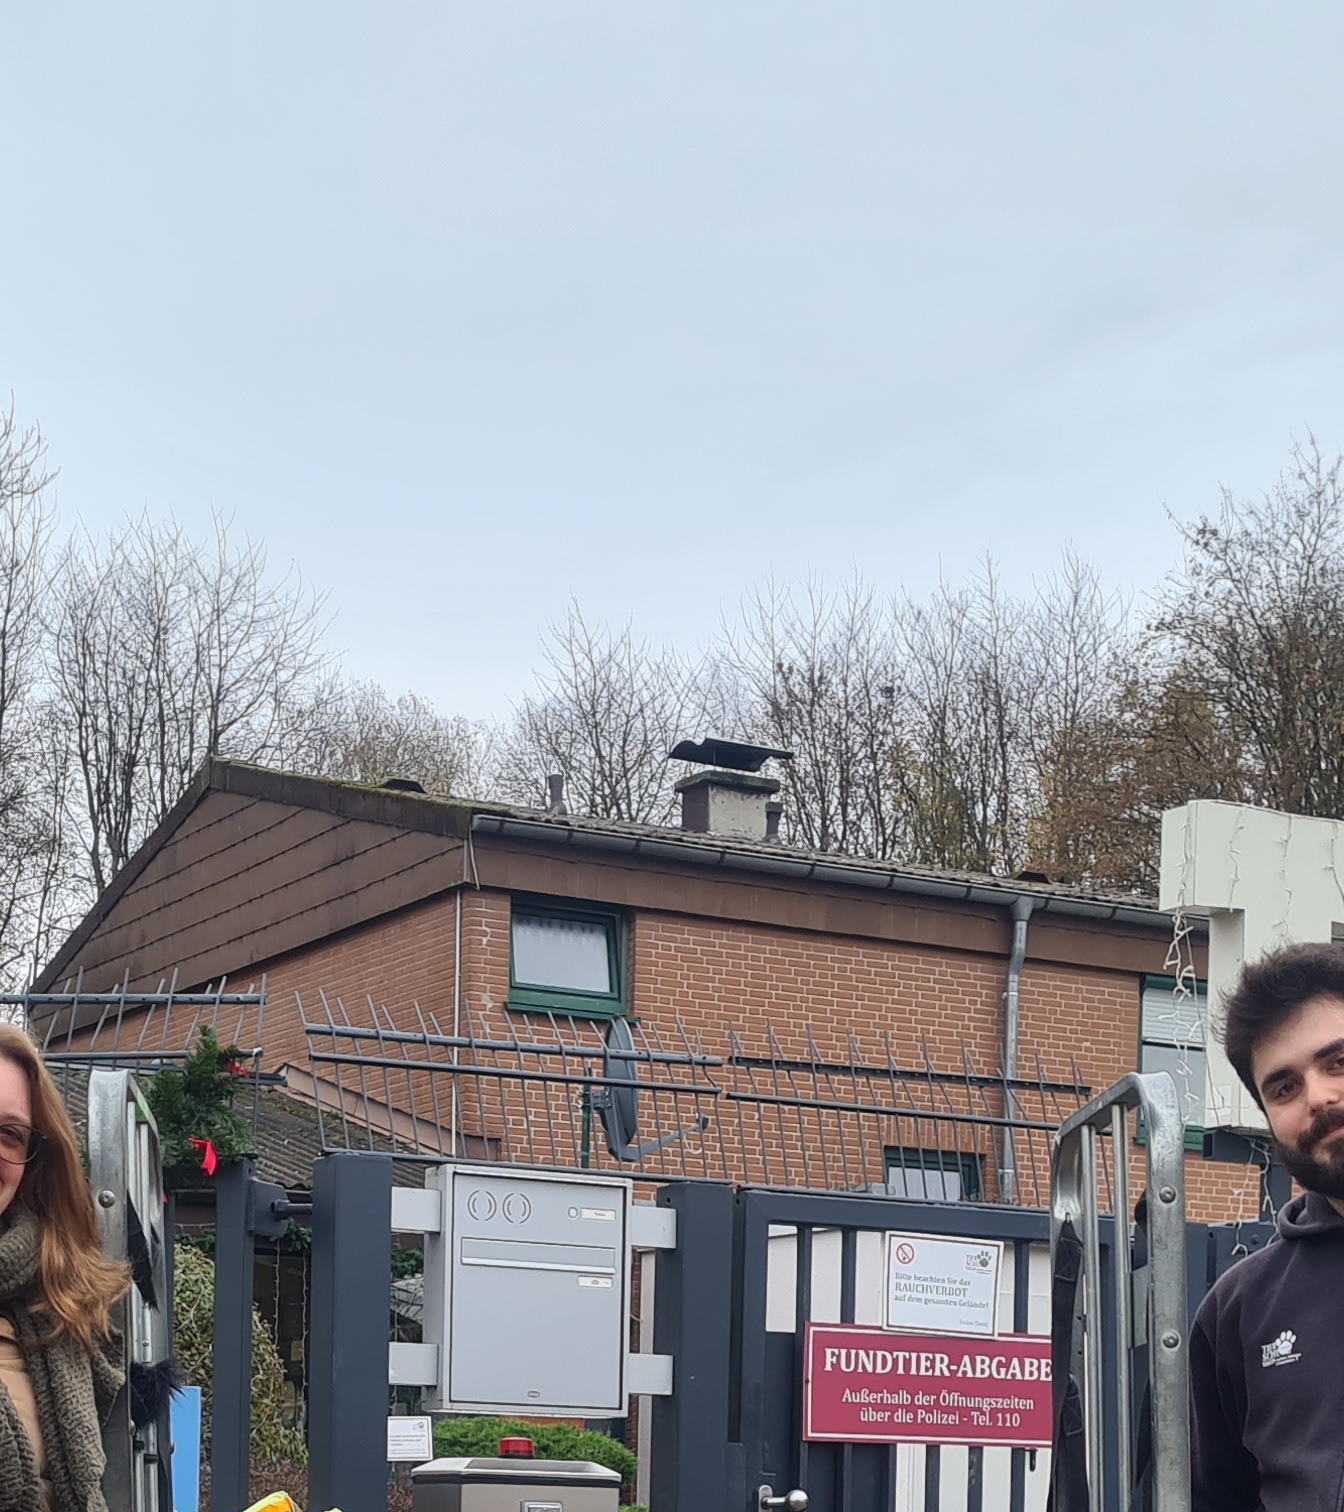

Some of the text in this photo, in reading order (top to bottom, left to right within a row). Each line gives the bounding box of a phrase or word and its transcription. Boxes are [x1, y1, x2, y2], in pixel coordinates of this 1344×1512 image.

[895, 1282, 968, 1298] RAUCHVERBOT
[958, 1277, 971, 1286] das
[824, 1348, 1053, 1381] FUNDTIER-ABGABE
[842, 1387, 1034, 1411] Außerhalb der Öffnungszeiten
[860, 1407, 891, 1422] über
[894, 1408, 914, 1423] die
[917, 1408, 959, 1425] Polizei
[971, 1411, 993, 1426] Tel.
[996, 1412, 1021, 1427] 110
